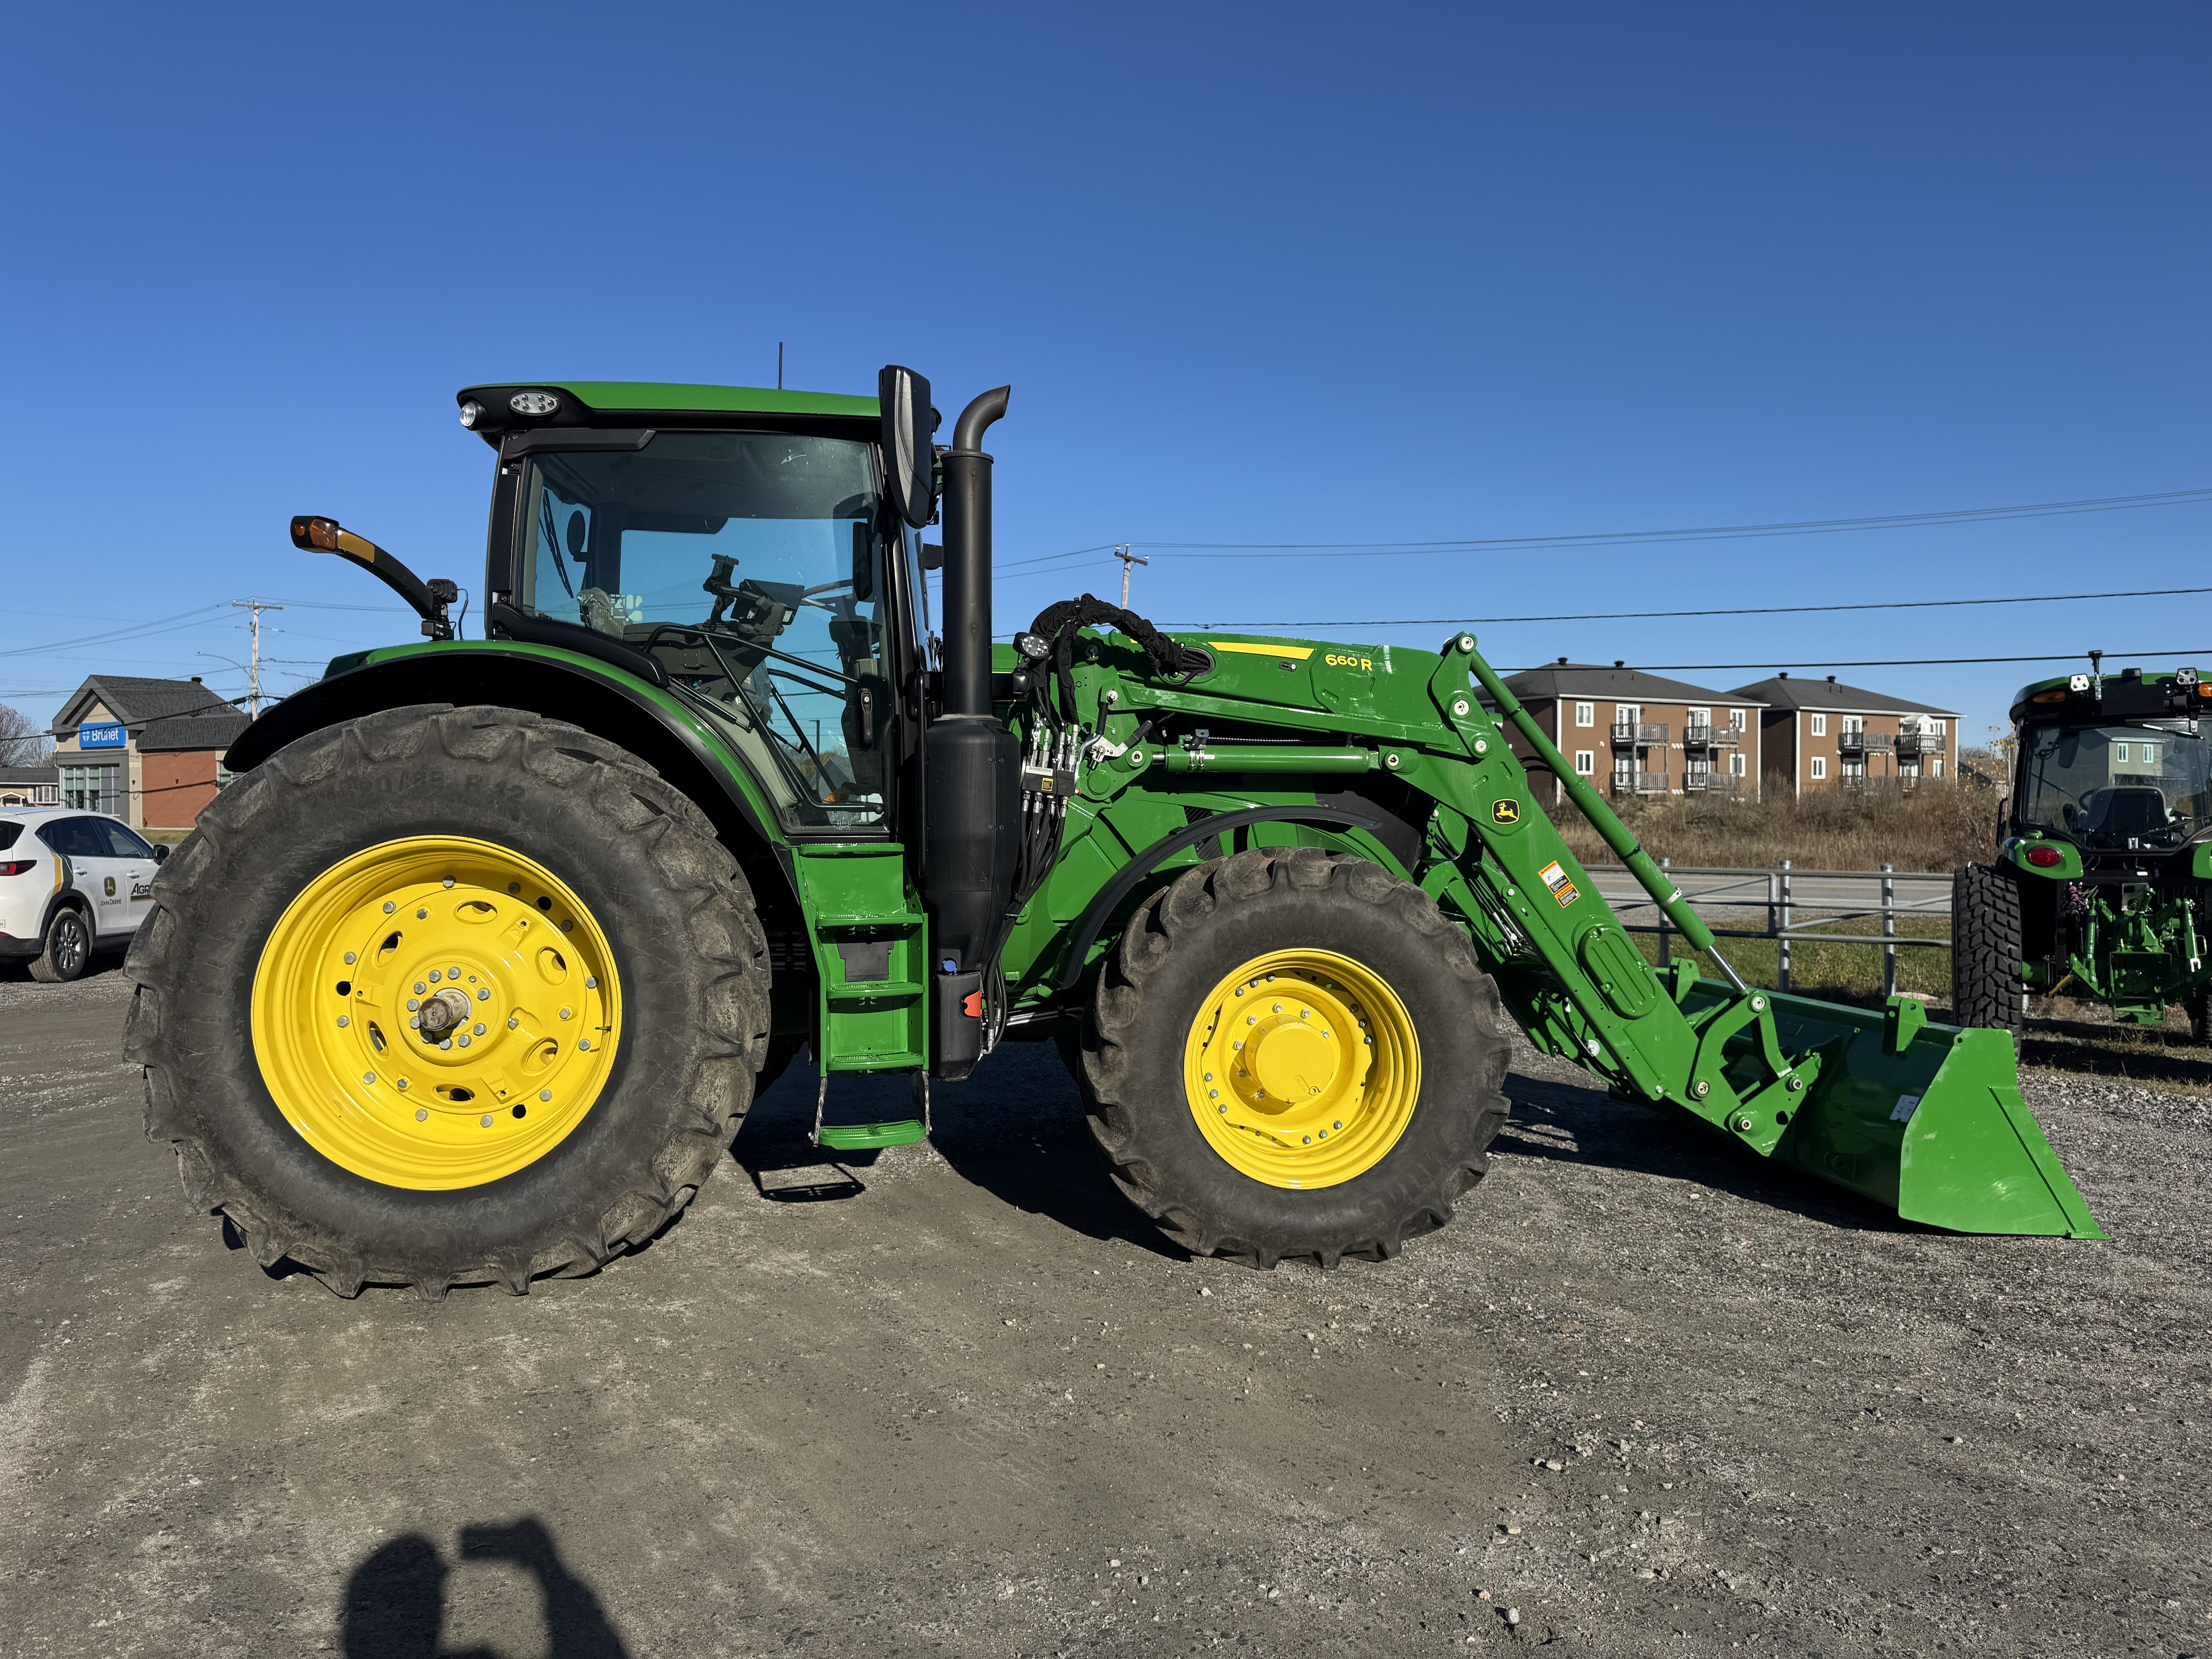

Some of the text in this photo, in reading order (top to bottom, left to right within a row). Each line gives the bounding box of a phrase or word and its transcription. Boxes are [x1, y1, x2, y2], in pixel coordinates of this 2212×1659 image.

[1325, 654, 1373, 671] 660 R
[92, 728, 118, 741] Brunet
